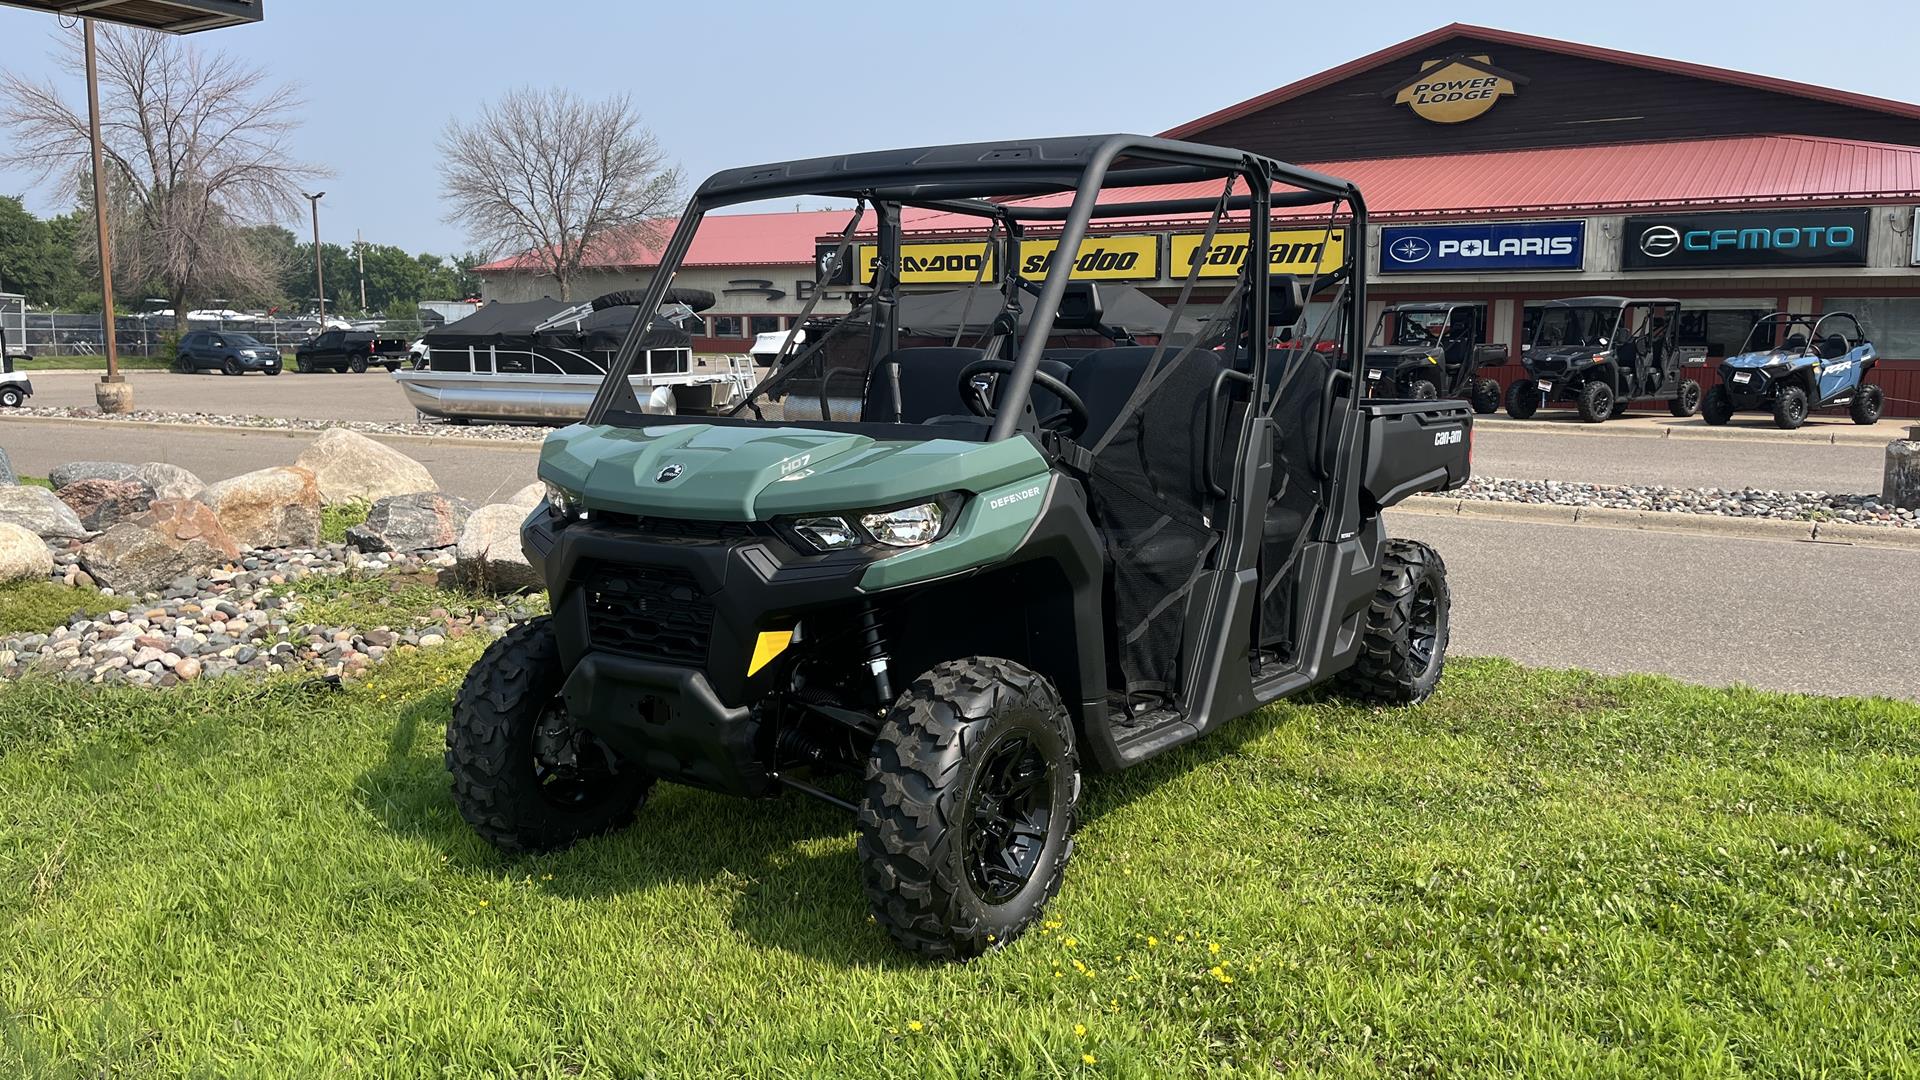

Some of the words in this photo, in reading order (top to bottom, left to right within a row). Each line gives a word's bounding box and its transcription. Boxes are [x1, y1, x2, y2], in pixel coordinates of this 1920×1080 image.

[1413, 77, 1498, 96] POWER
[1417, 89, 1494, 105] LODGE
[1438, 237, 1573, 258] POLARIS
[1684, 226, 1854, 251] CFMOTO
[1022, 248, 1139, 273] s-doo
[1187, 242, 1325, 266] canam
[1434, 430, 1462, 446] can-am
[990, 486, 1040, 510] DEFENDER
